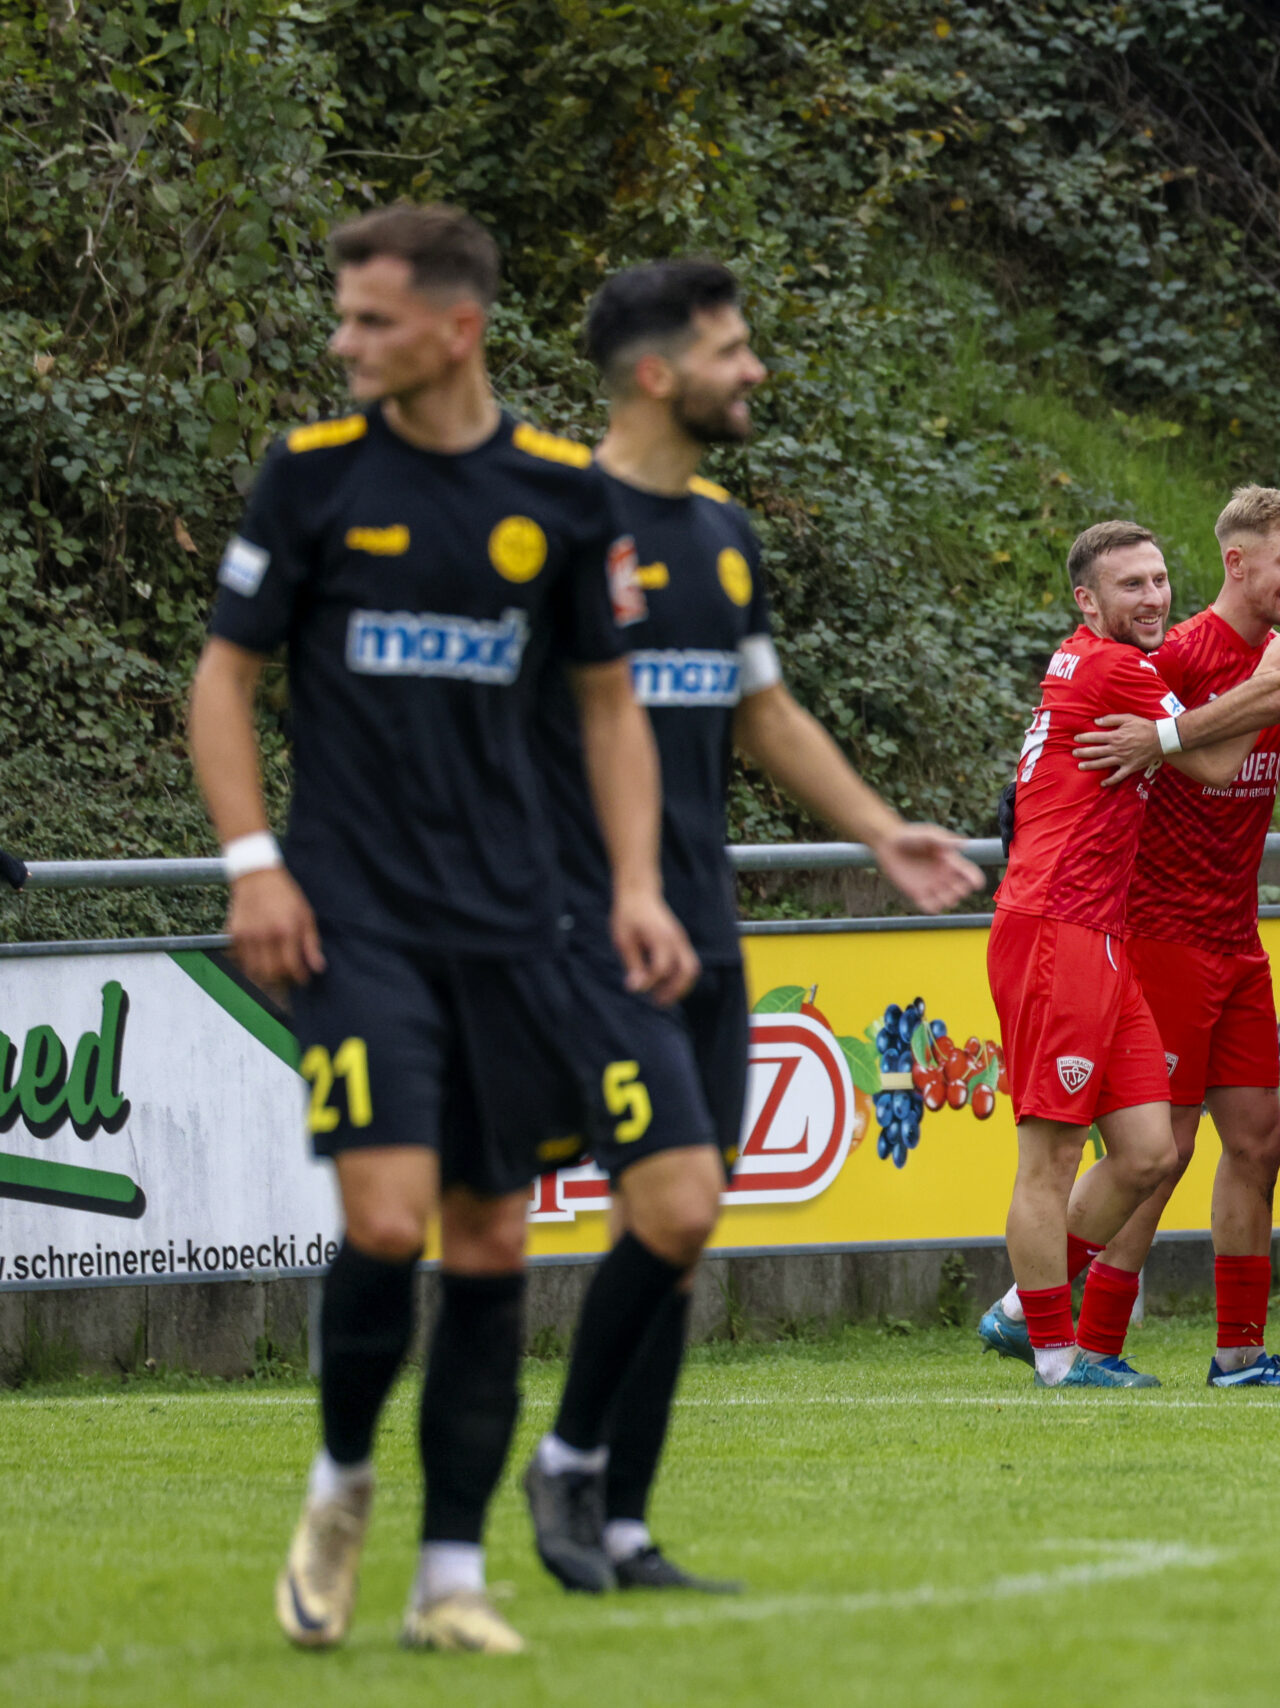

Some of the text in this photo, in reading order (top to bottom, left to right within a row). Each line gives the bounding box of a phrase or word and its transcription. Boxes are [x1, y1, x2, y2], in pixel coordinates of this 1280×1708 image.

[301, 1036, 372, 1132] 21
[602, 1059, 653, 1144] 5
[0, 1232, 339, 1281] .schreinerei-kopecki.de
